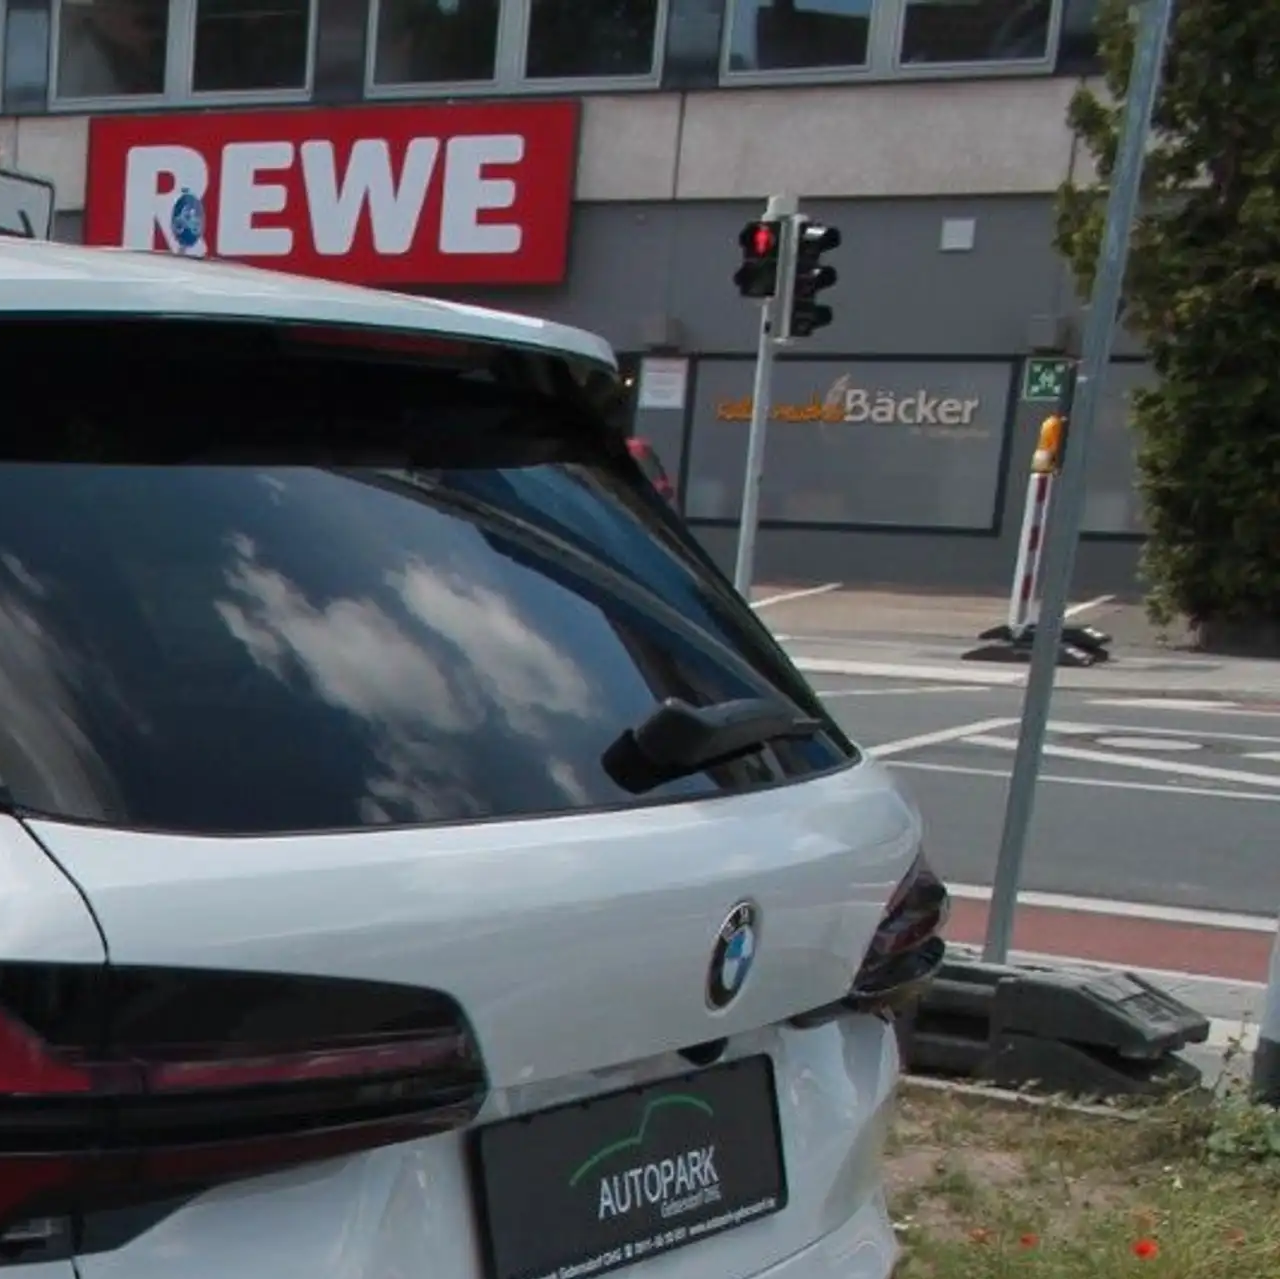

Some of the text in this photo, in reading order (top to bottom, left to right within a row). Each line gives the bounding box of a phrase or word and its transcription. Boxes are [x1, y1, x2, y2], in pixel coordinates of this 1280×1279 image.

[122, 134, 525, 259] REWE
[843, 388, 980, 425] Bäcker
[598, 1145, 719, 1219] AUTOPARK
